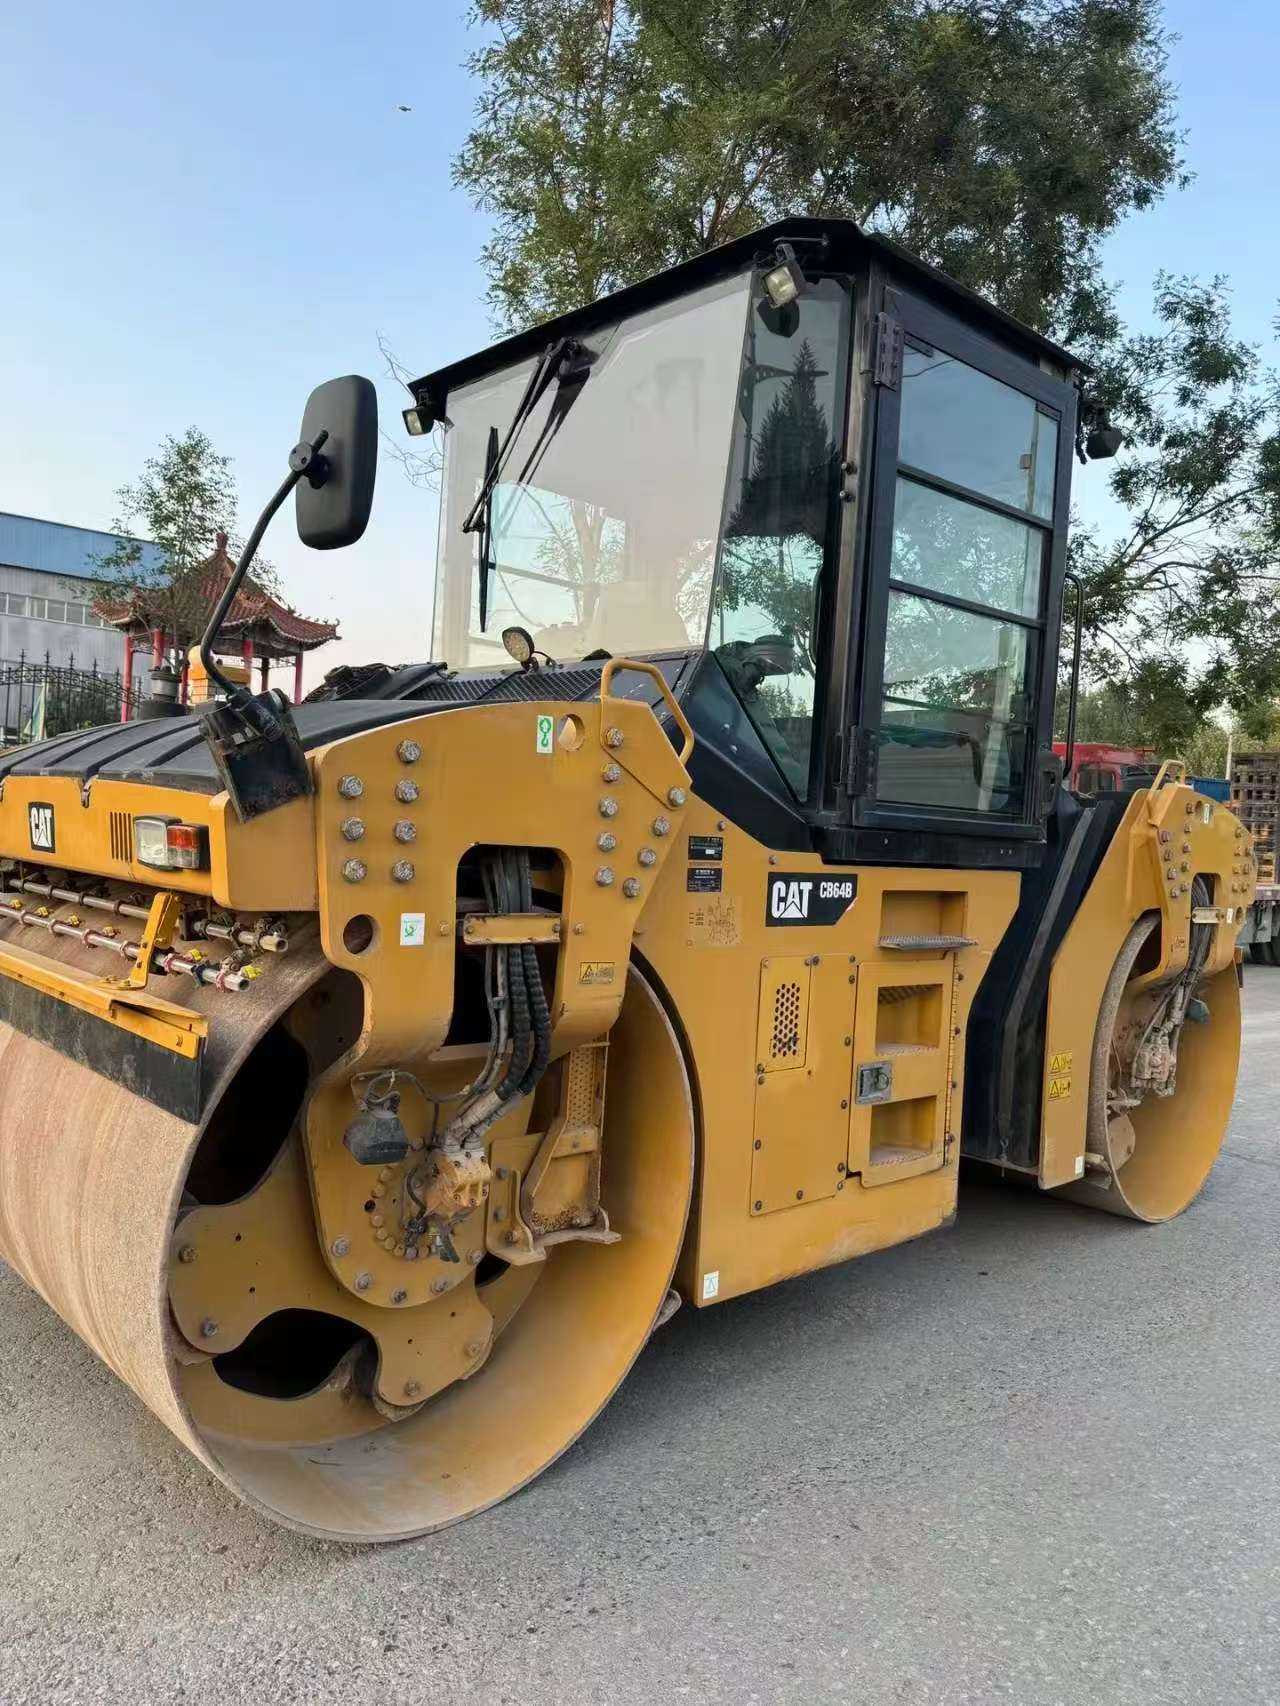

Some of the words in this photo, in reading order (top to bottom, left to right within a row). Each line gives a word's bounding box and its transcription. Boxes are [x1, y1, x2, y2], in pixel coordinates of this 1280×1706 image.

[31, 807, 52, 847] CAT
[771, 881, 813, 919] CAT
[820, 882, 853, 898] CB64B
